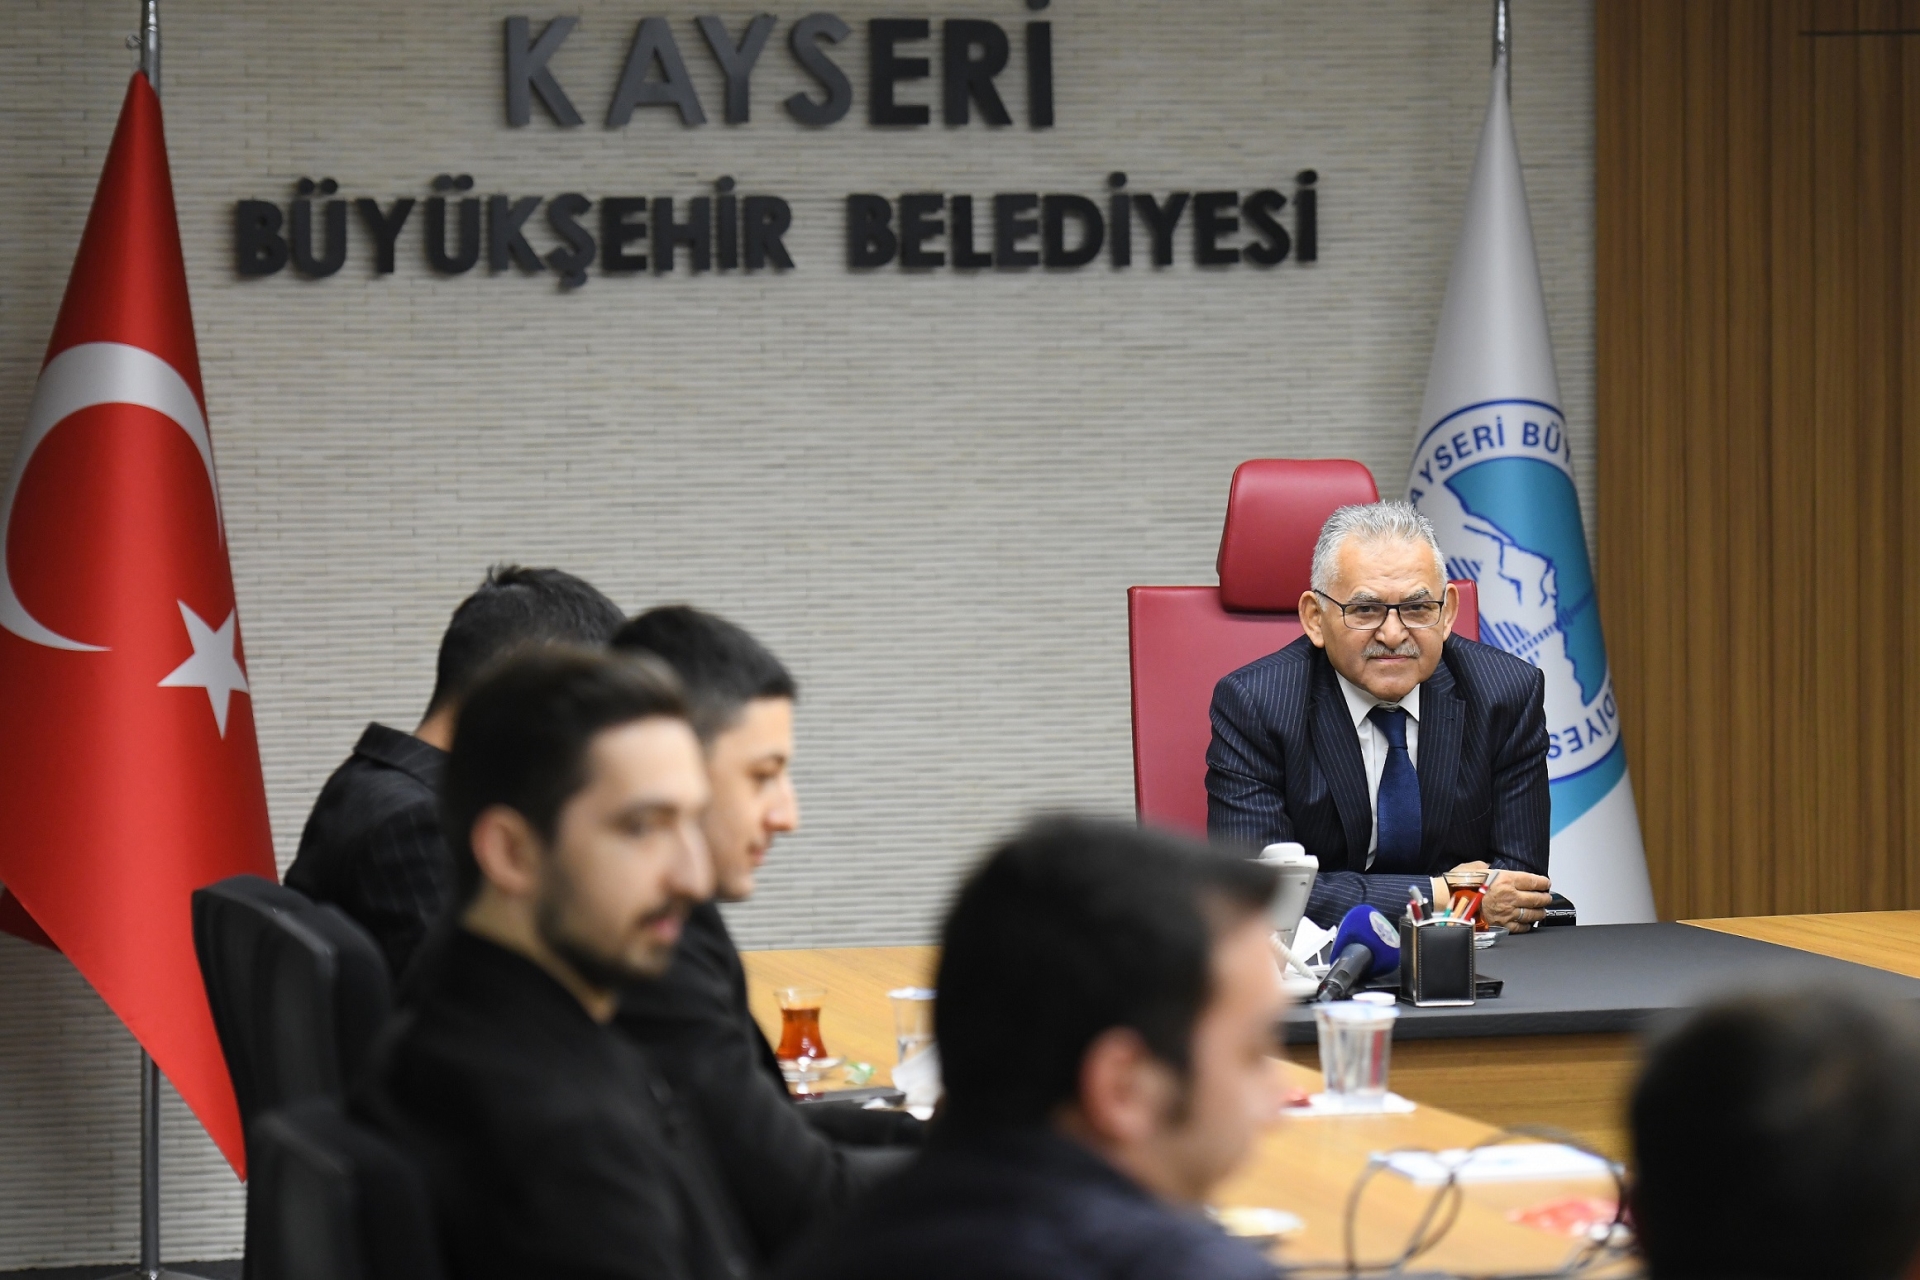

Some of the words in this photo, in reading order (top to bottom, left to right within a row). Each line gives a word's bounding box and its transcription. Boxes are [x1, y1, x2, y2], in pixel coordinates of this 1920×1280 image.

[503, 0, 1054, 128] KAYSERİ
[235, 174, 795, 289] BÜYÜKŞEHİR
[846, 169, 1318, 270] BELEDİYESİ
[1410, 415, 1505, 508] AYSERİ
[1547, 680, 1617, 760] DİYES
